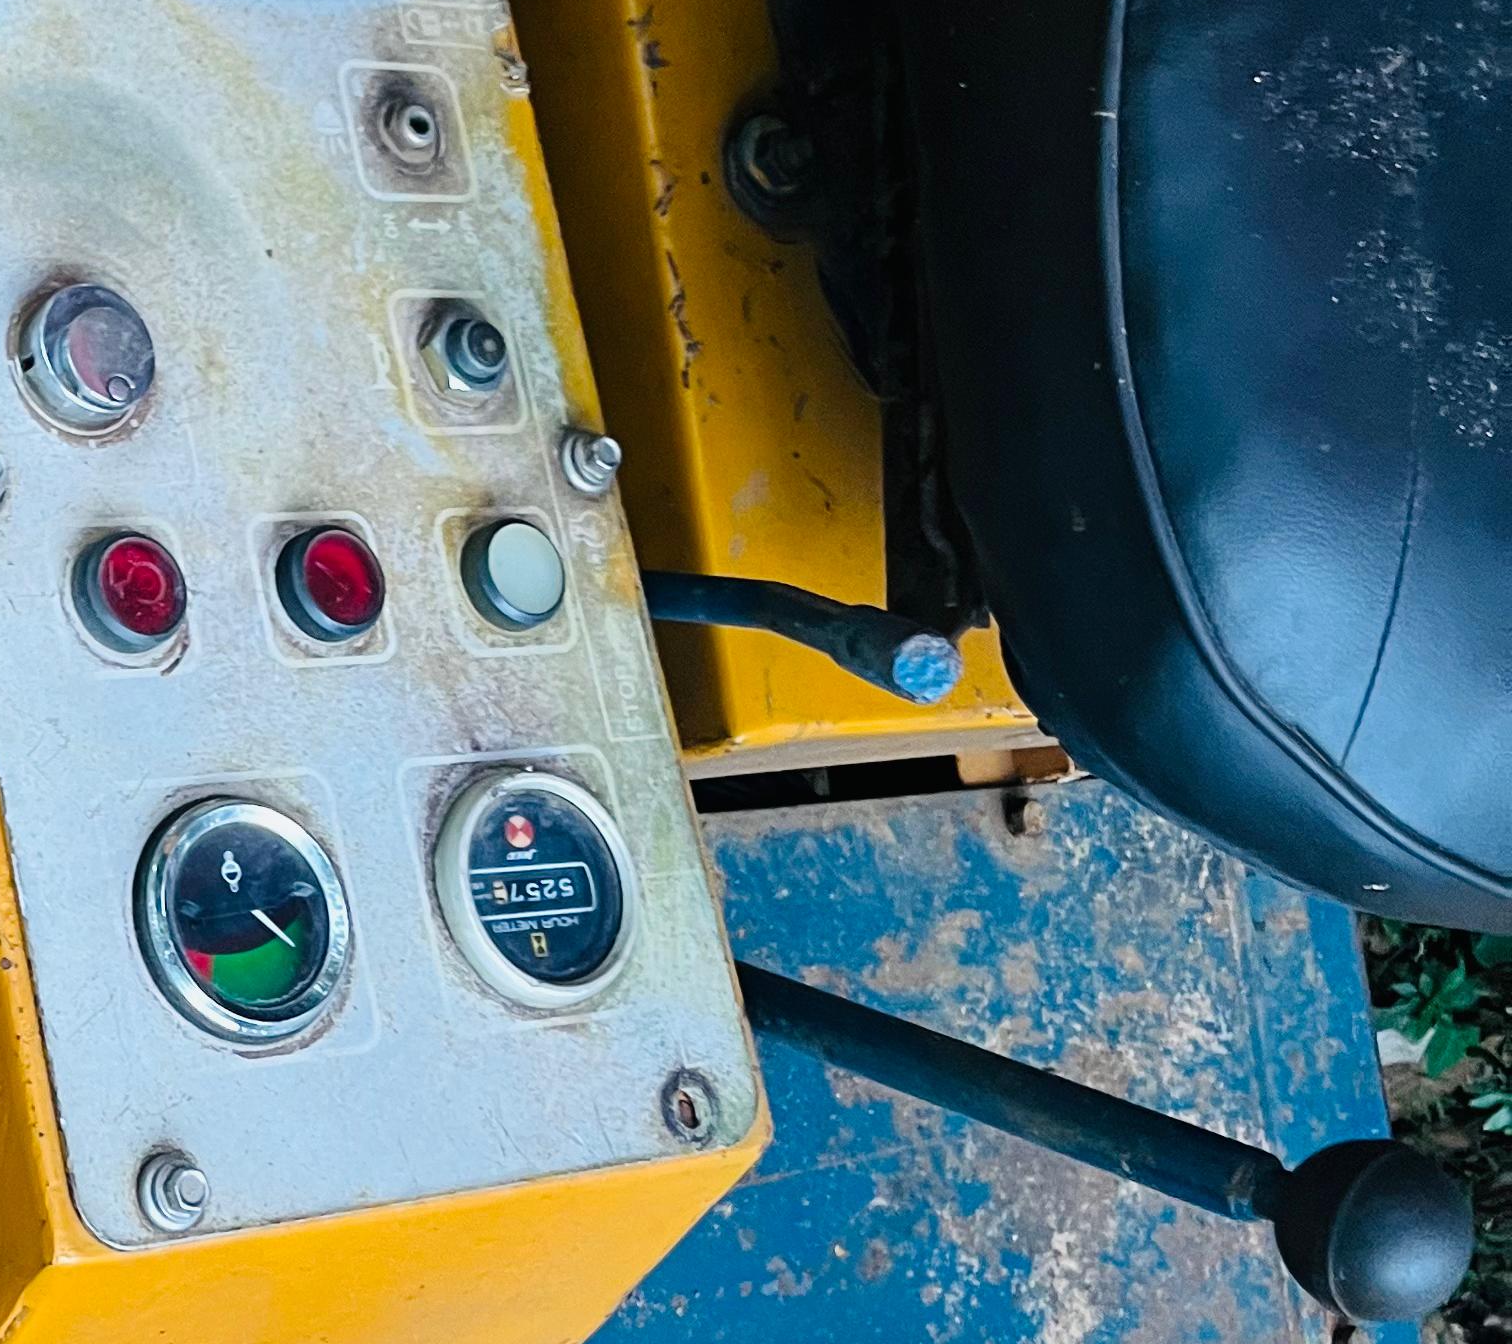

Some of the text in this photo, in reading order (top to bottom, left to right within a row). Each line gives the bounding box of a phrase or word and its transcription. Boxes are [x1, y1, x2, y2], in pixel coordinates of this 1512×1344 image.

[613, 664, 645, 733] STOP
[491, 914, 580, 934] HOUR METER
